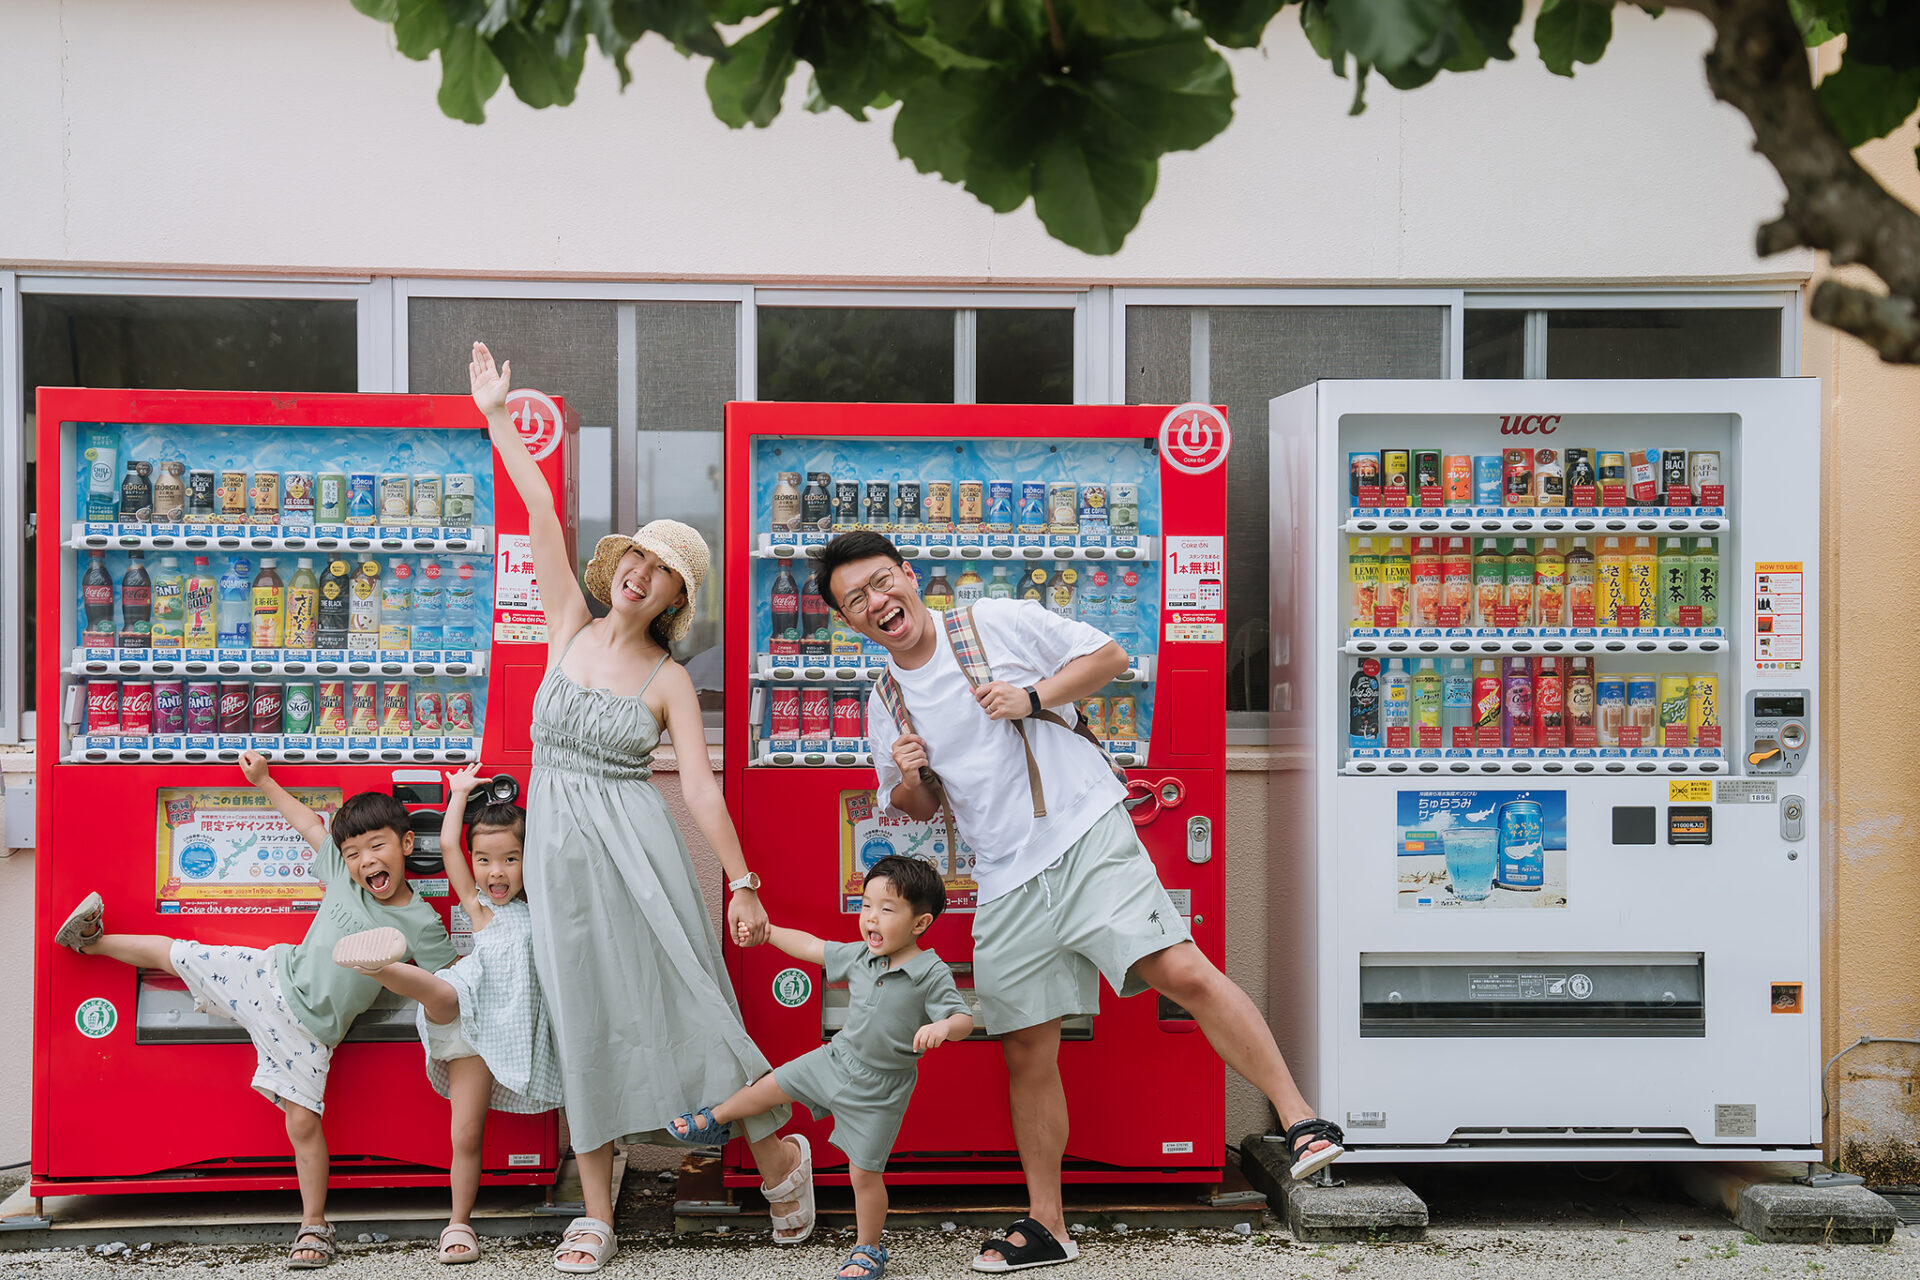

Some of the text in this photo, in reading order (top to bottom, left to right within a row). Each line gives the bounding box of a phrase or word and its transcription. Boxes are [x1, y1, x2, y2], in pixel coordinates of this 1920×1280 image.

[1668, 568, 1685, 603] お茶
[1699, 568, 1716, 602] お茶
[1608, 566, 1621, 620] さんぴん茶
[1640, 566, 1651, 620] さんぴん茶
[188, 696, 214, 708] FANTA
[227, 696, 240, 704] Dr
[263, 697, 274, 706] Dr
[354, 700, 372, 708] GOLD
[386, 700, 404, 708] GOLD
[221, 700, 244, 714] Pepper
[256, 701, 280, 715] Pepper
[168, 800, 190, 811] 沖縄
[848, 798, 868, 807] 沖縄
[1418, 798, 1472, 808] ちゅらうみ
[170, 812, 190, 822] 限定
[850, 809, 868, 818] 限定
